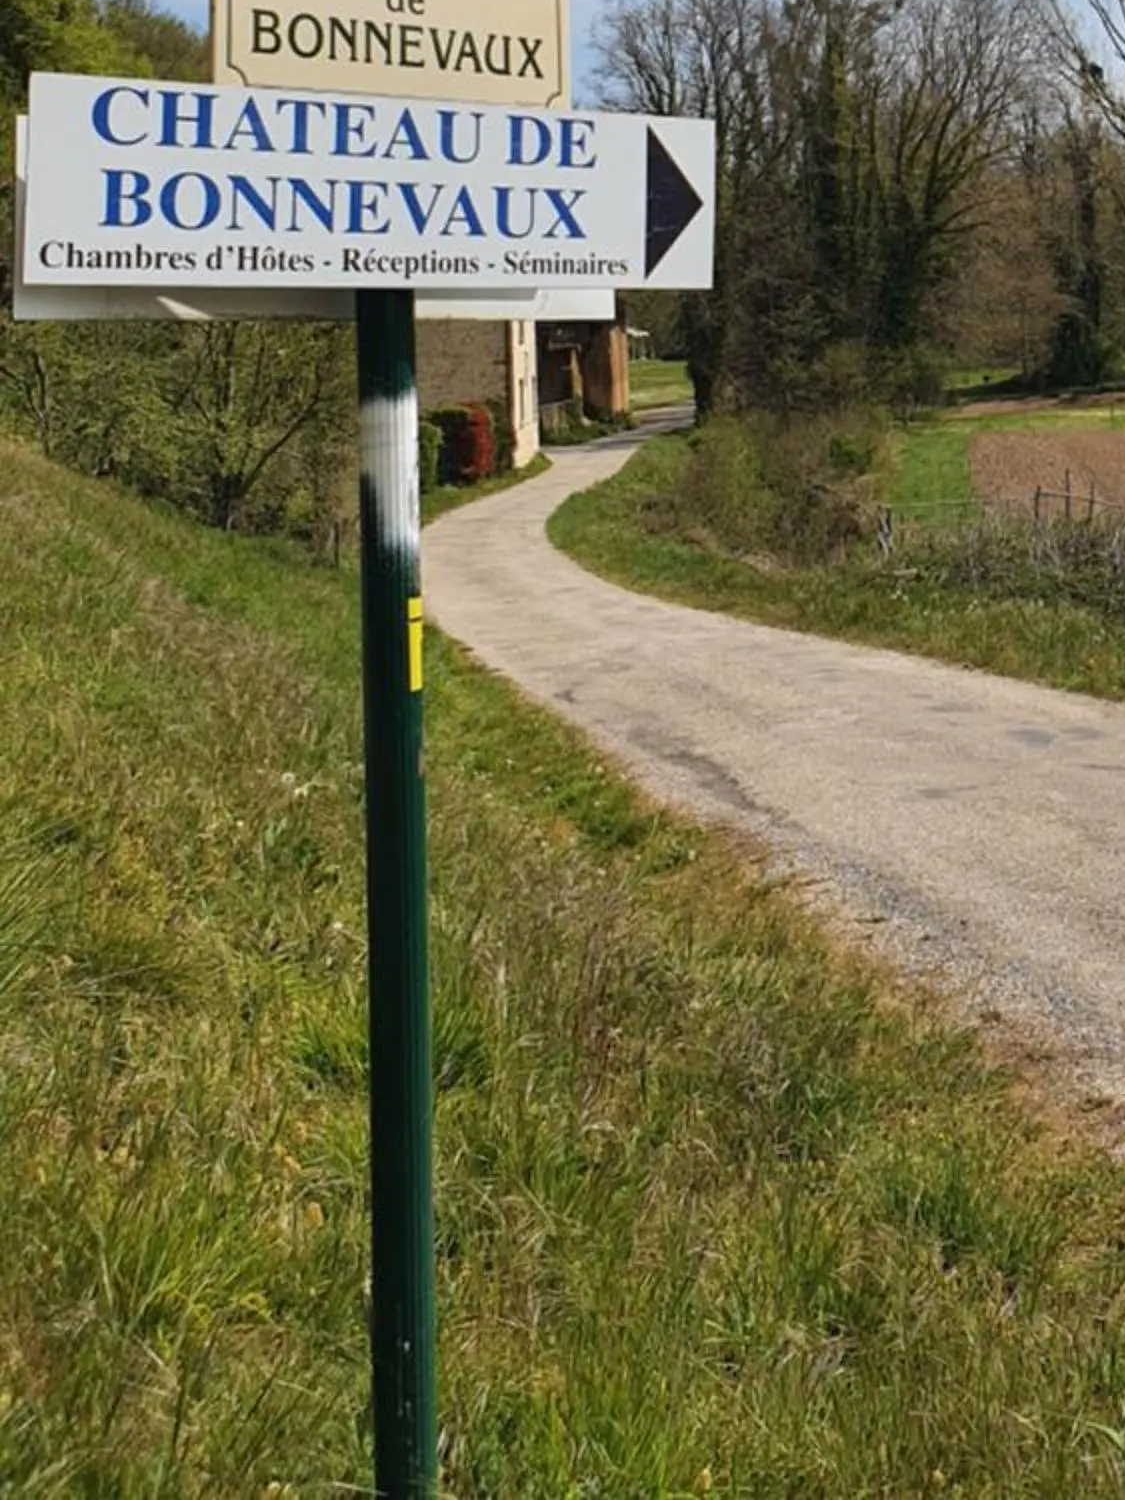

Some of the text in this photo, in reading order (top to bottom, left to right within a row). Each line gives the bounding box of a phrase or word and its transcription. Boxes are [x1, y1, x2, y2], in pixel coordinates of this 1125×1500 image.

[251, 8, 545, 80] BONNEVAUX
[91, 86, 598, 169] CHATEAU DE
[98, 168, 588, 240] BONNEVAUX
[39, 240, 197, 271] Chambres
[342, 248, 480, 280] Réceptions
[503, 251, 629, 277] Séminaires
